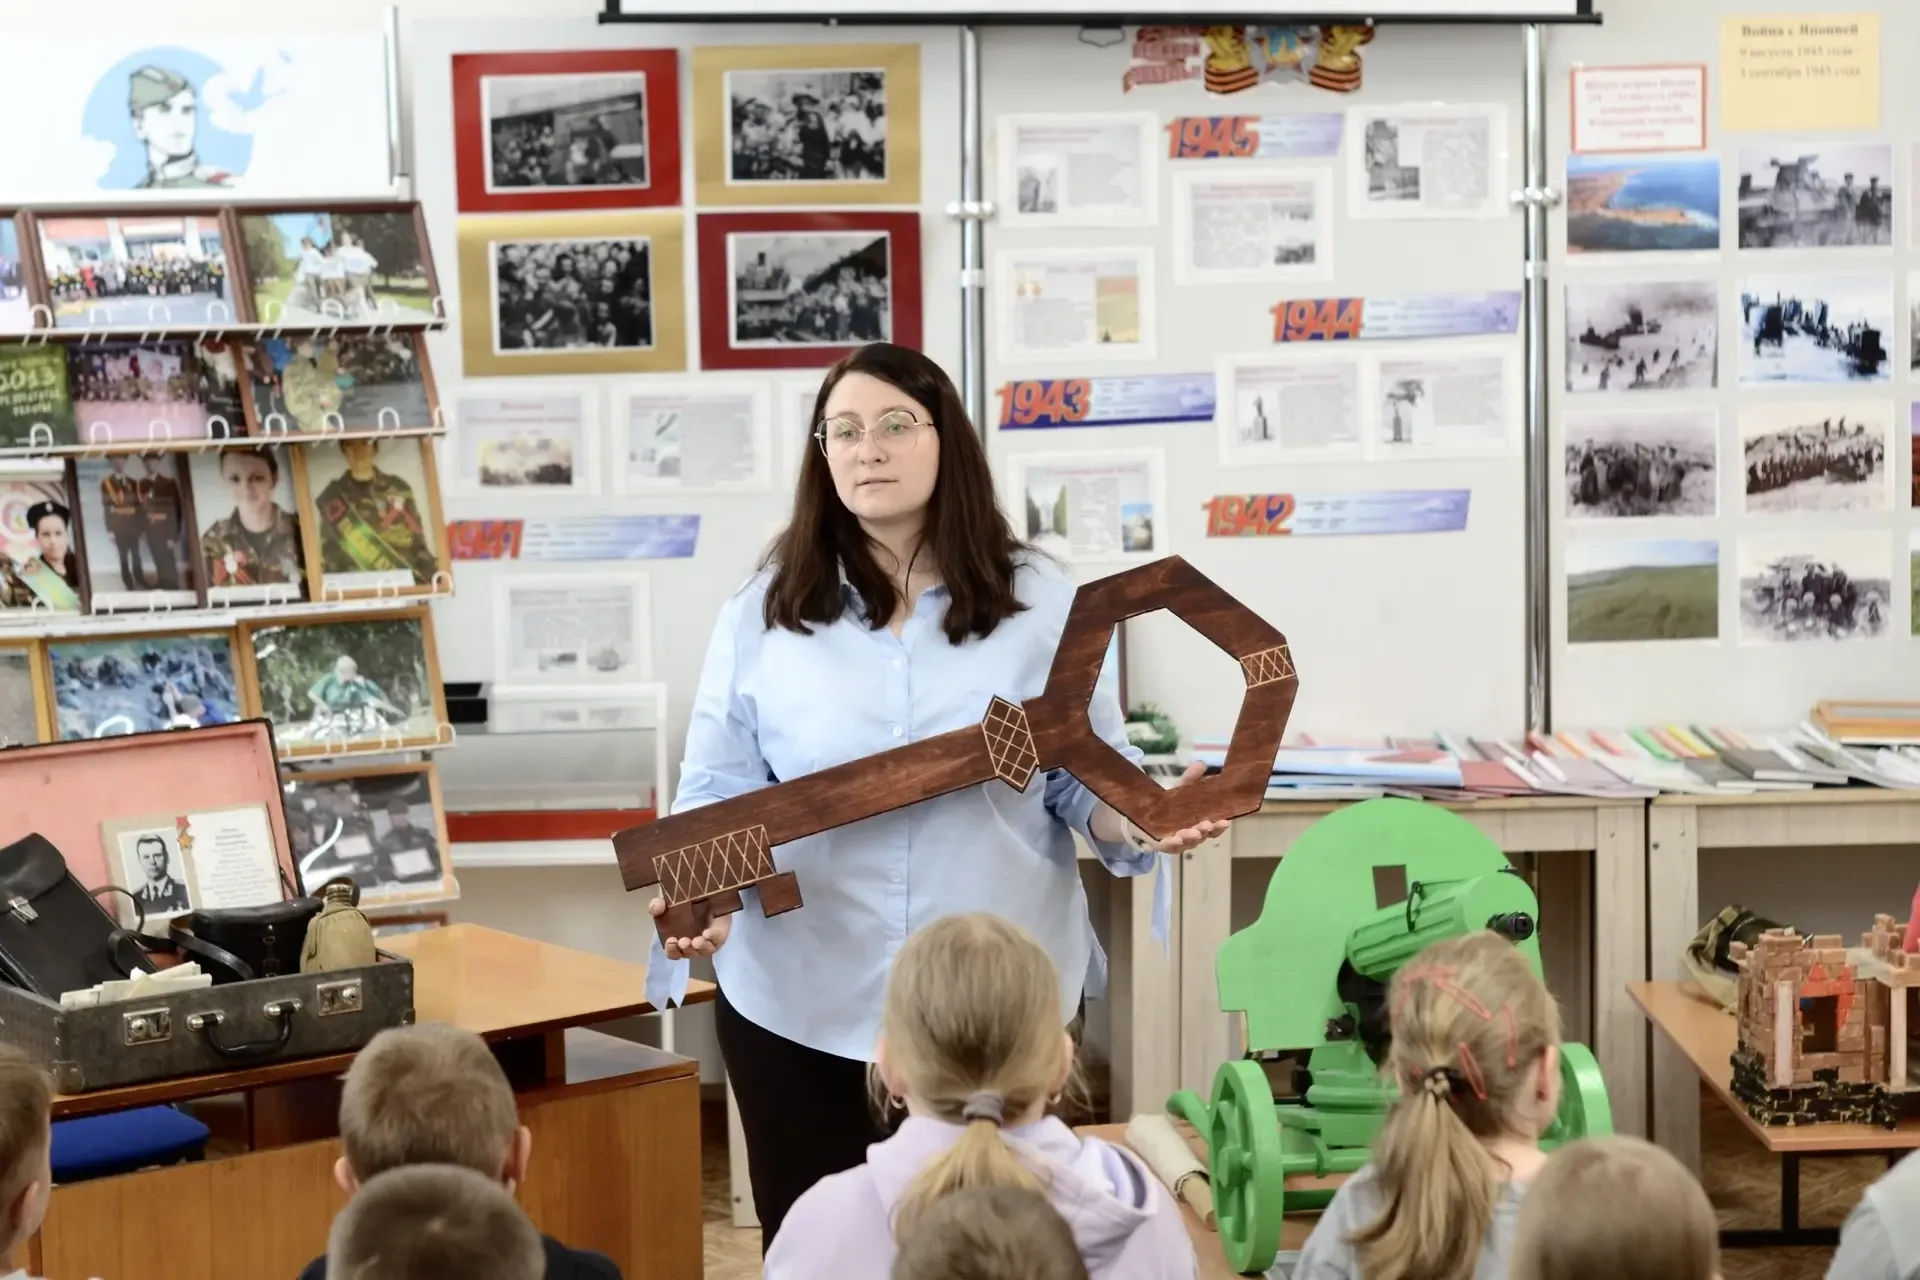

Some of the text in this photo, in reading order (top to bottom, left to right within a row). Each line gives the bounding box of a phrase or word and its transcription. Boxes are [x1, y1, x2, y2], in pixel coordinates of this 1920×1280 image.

[1742, 23, 1785, 37] Война
[1164, 115, 1262, 159] 1945
[1269, 297, 1364, 342] 1944
[995, 377, 1092, 426] 1943
[1202, 493, 1296, 538] 1942
[446, 518, 524, 561] 1941
